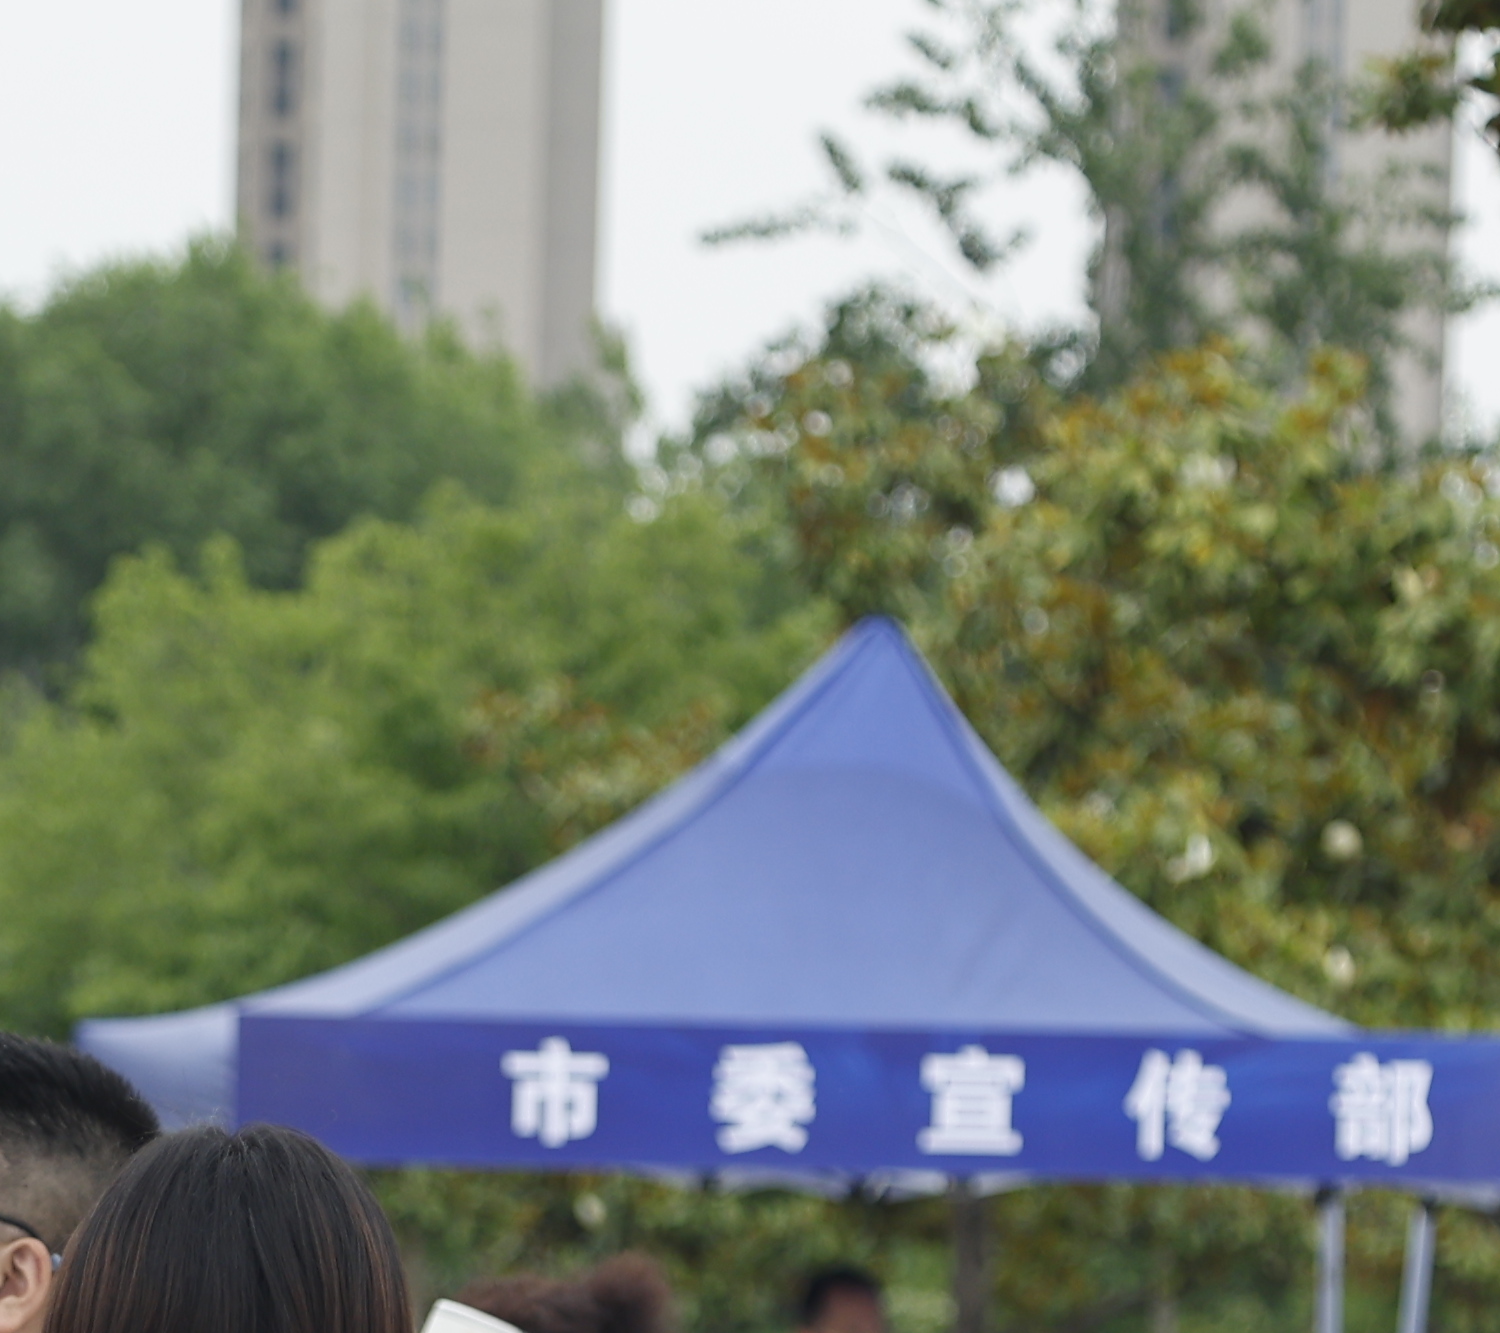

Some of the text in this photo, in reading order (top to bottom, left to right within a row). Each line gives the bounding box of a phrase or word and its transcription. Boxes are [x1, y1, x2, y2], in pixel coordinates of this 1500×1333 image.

[502, 1035, 1435, 1166] 市委宣传部
